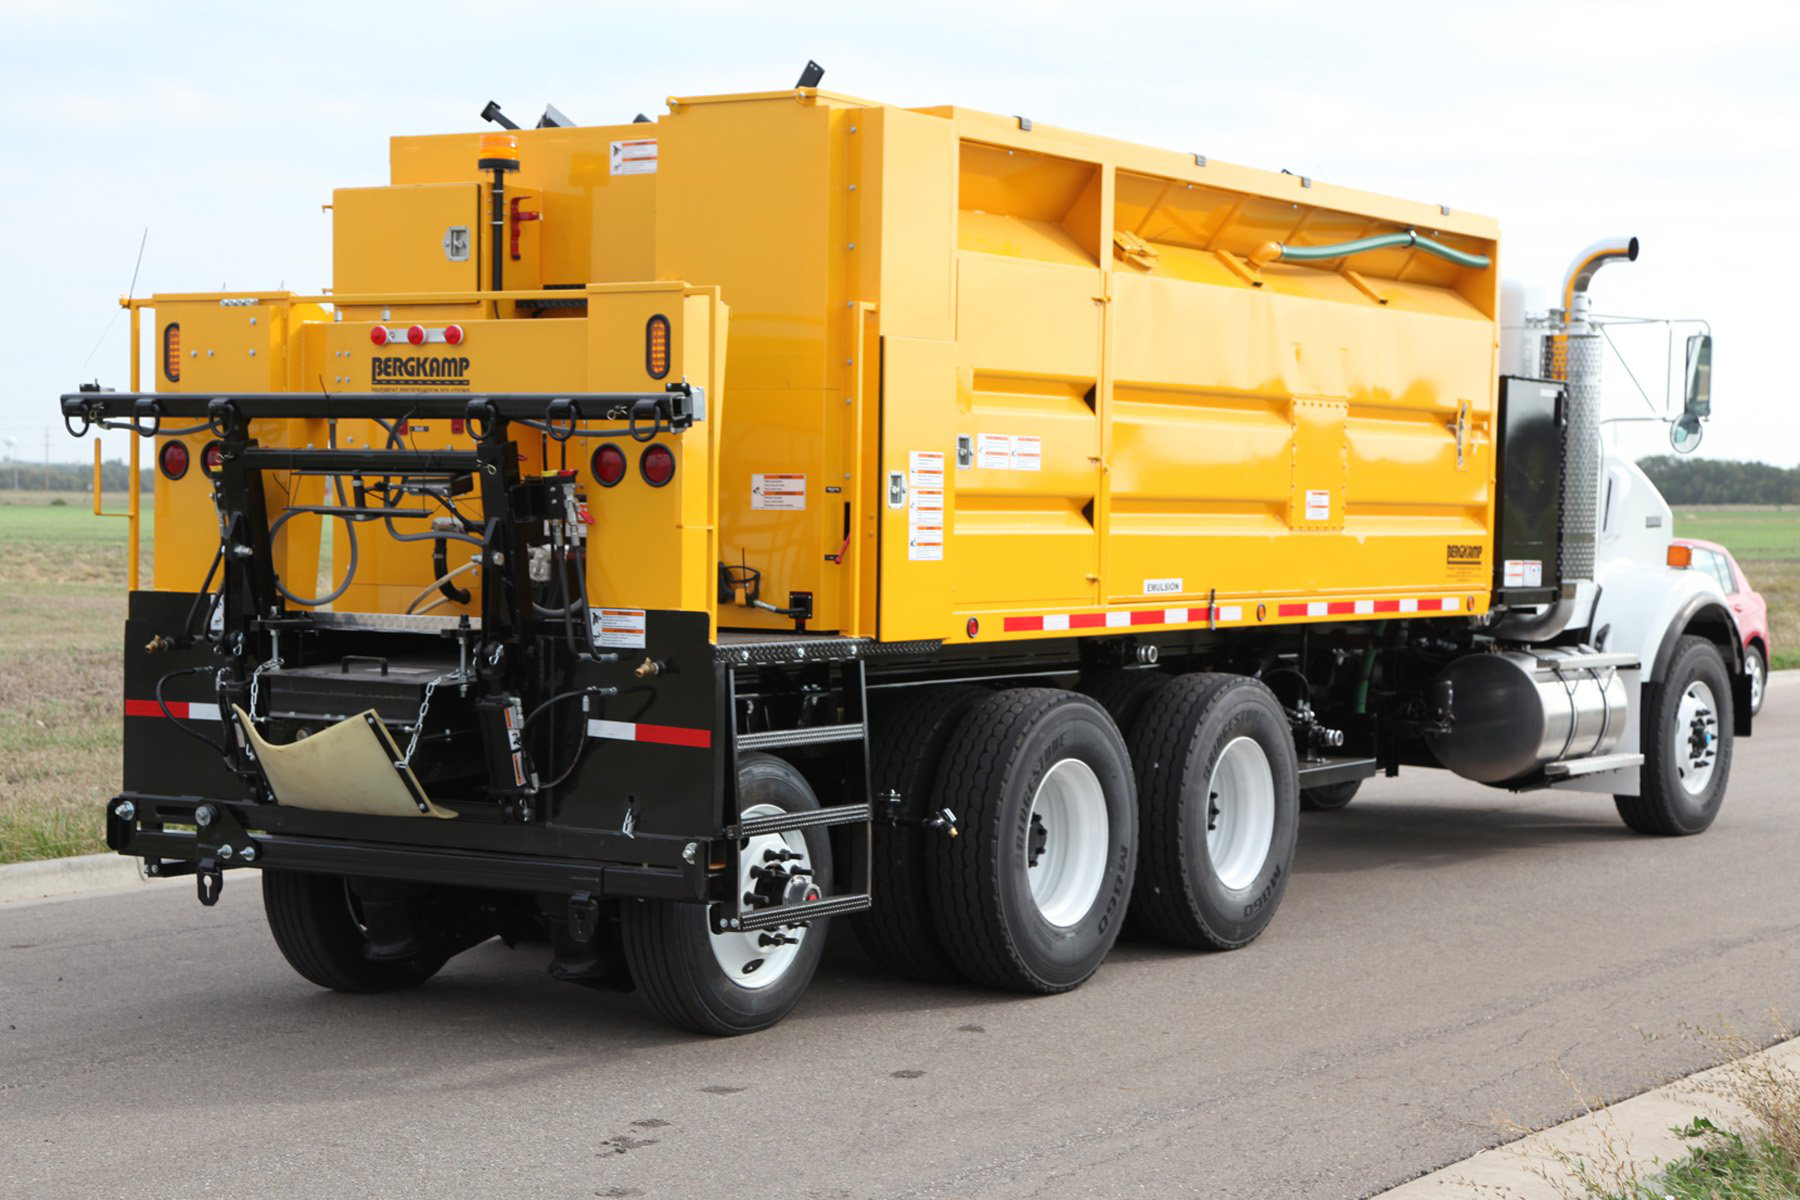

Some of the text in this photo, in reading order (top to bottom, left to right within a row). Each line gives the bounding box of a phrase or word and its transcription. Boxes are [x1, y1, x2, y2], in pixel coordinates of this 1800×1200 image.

[371, 356, 470, 379] BERGKAMP
[1446, 545, 1483, 560] BERGKAMP
[1147, 582, 1180, 592] EMULSION
